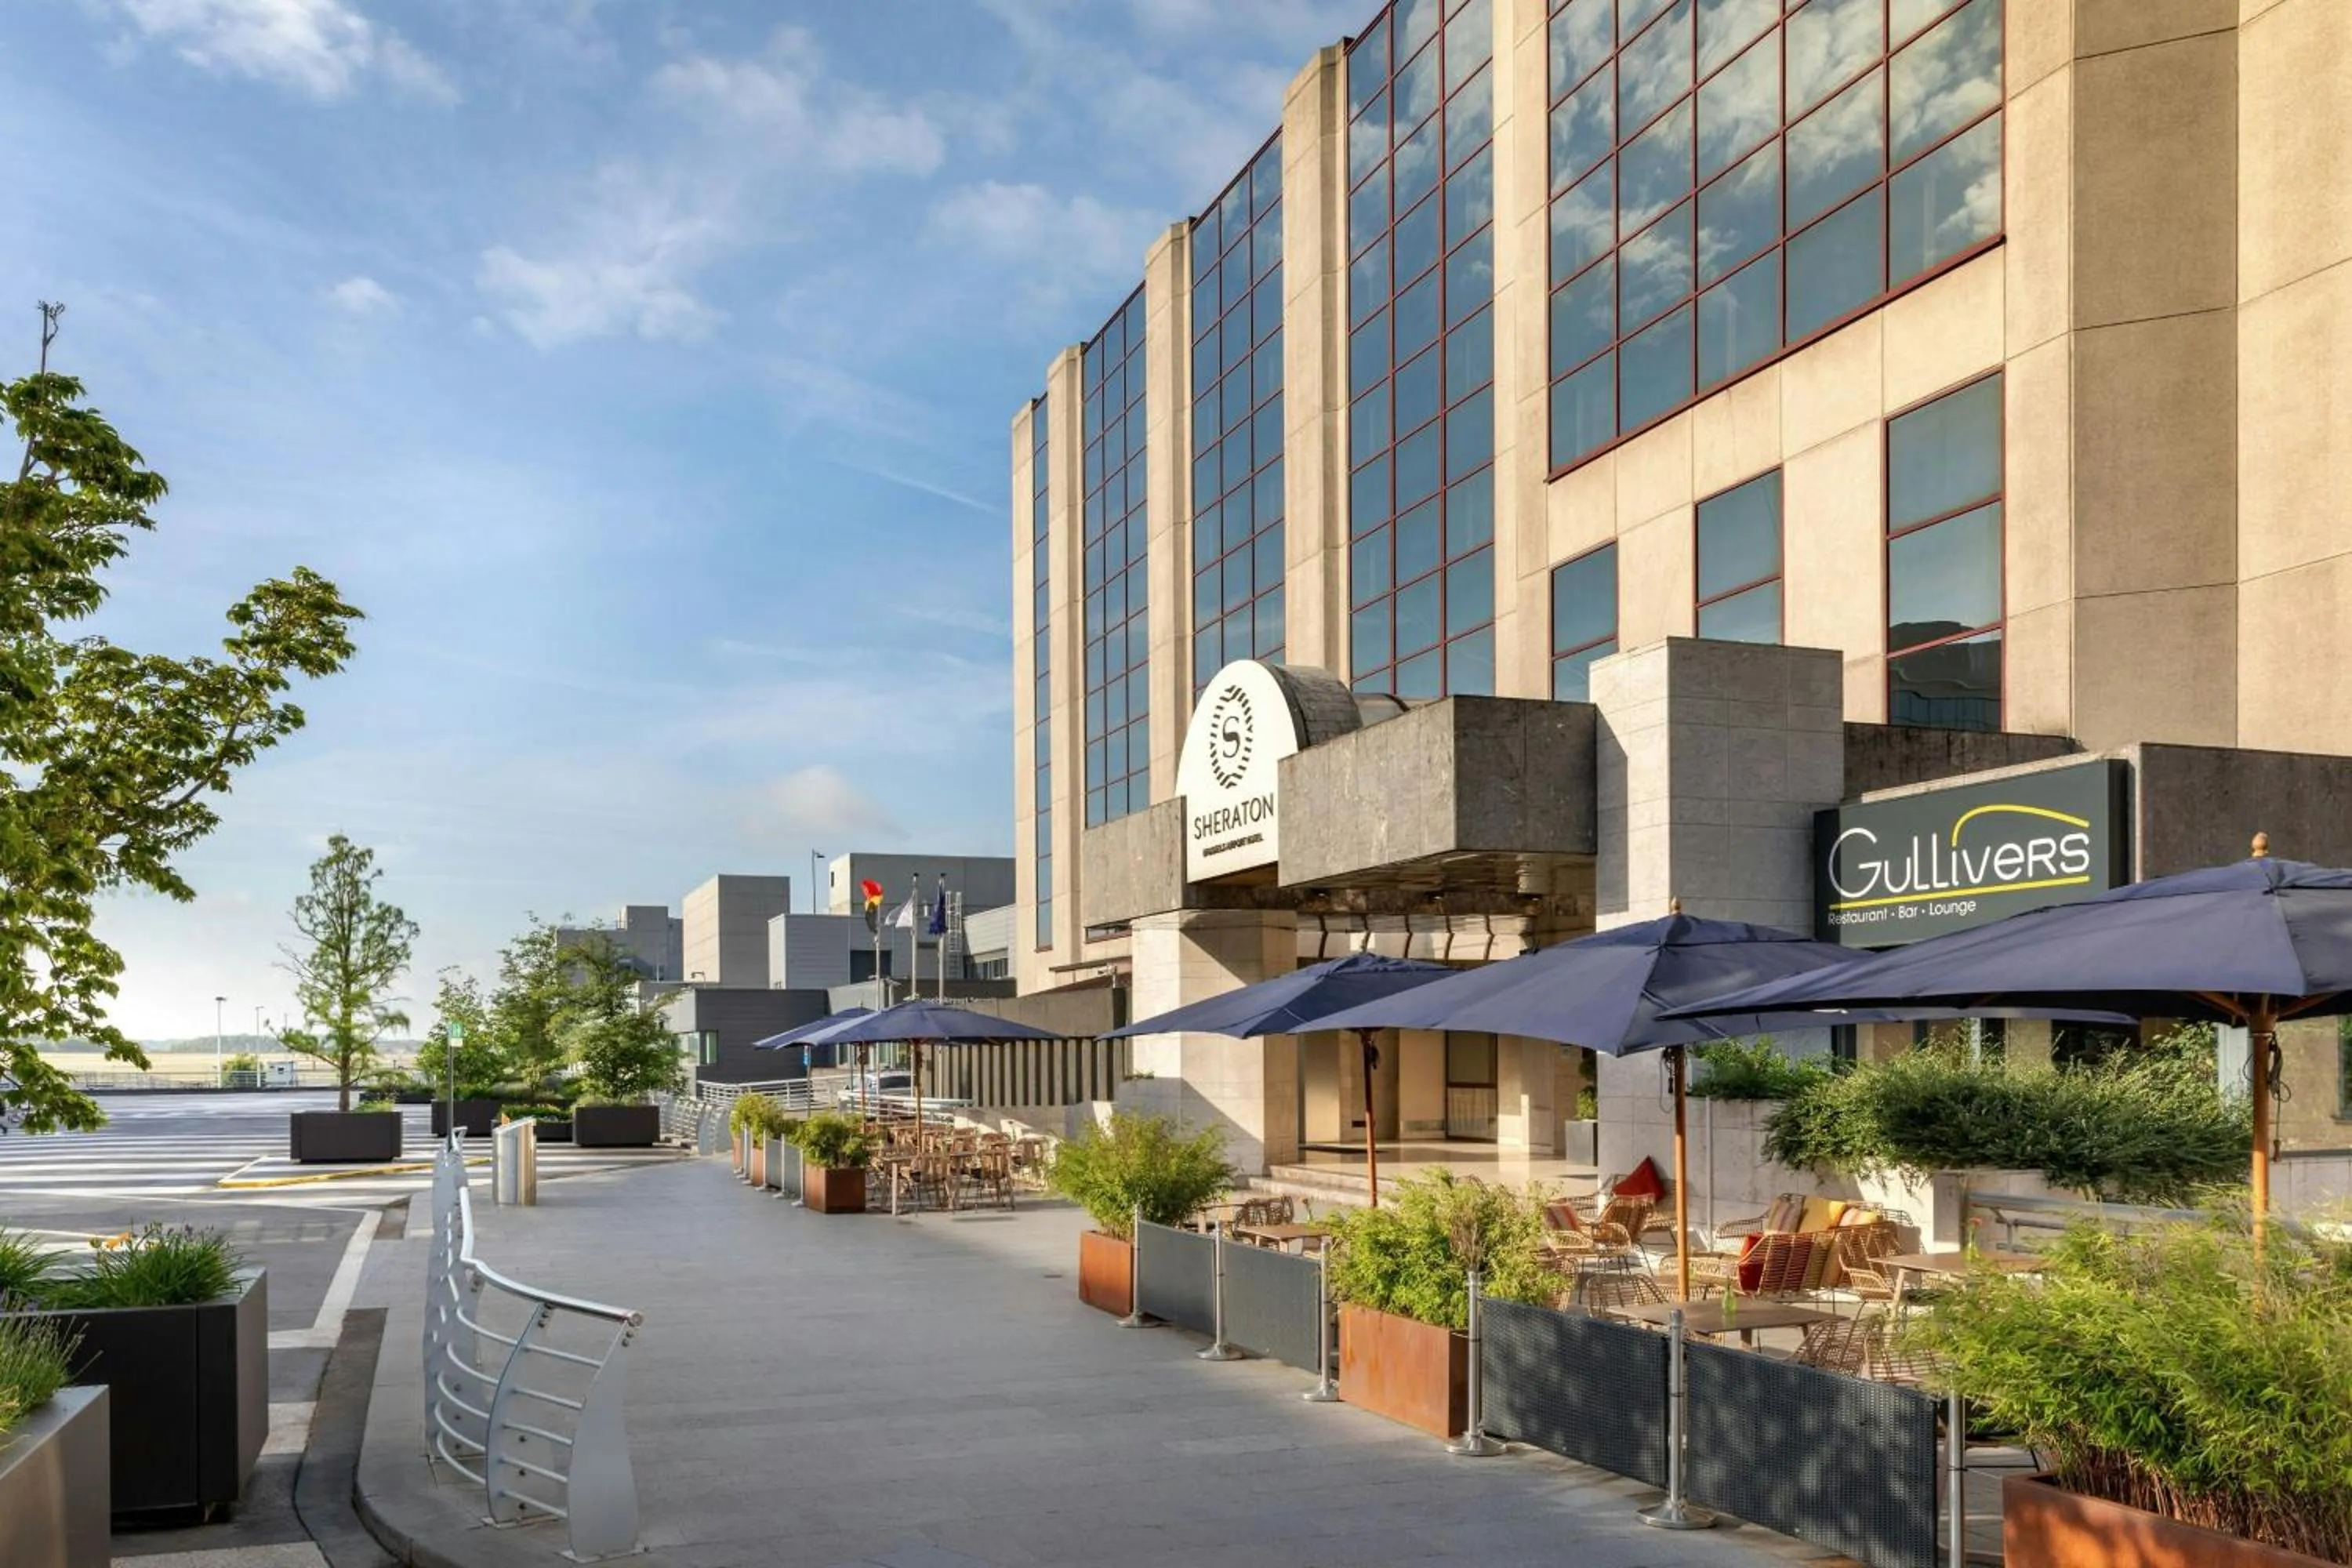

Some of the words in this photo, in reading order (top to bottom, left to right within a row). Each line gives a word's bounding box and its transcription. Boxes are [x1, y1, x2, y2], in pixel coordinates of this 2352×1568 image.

[1221, 716, 1241, 759] S
[1194, 792, 1274, 840] SHERATON
[1828, 908, 1888, 926] Restaurant
[1898, 906, 1918, 919] Bar
[1929, 901, 1977, 916] Lounge
